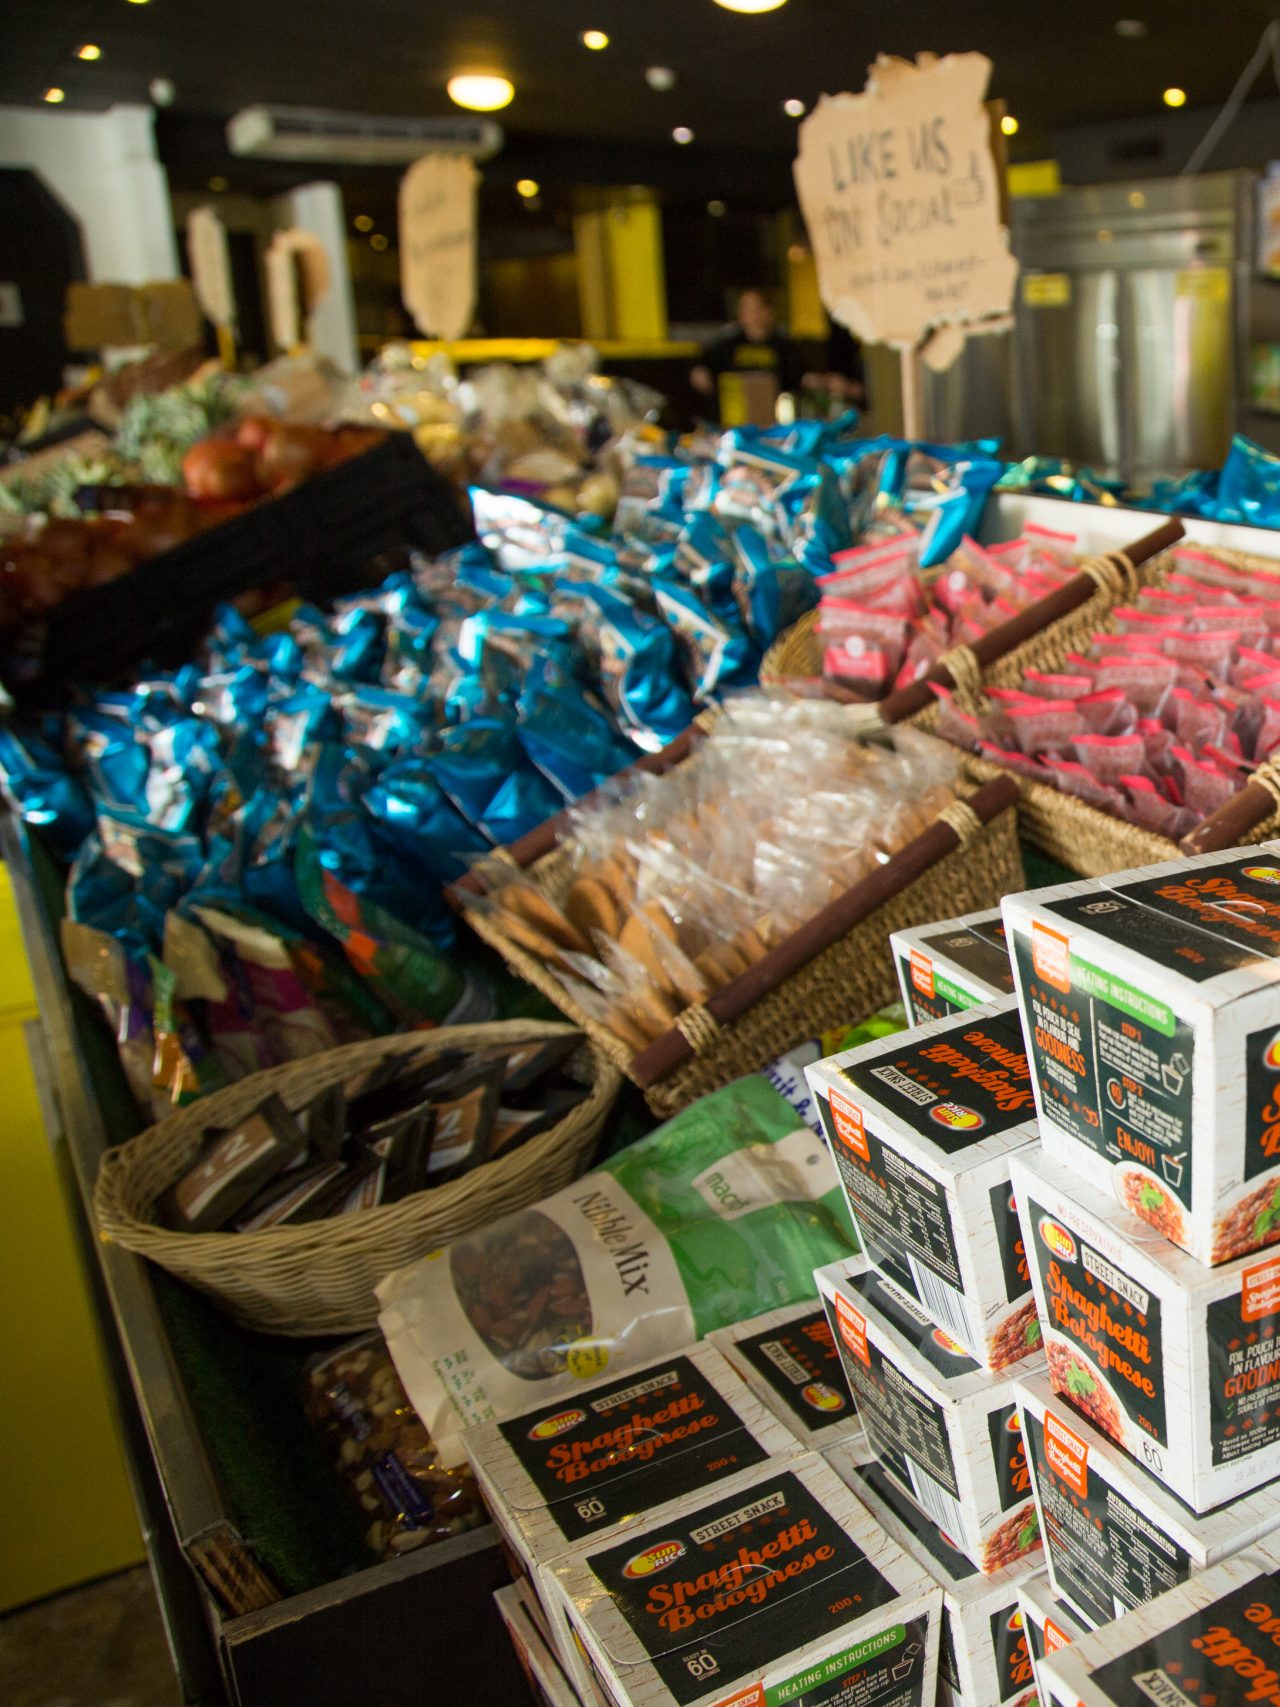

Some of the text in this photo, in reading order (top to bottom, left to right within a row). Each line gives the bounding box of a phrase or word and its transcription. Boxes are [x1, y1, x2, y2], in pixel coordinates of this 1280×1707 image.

[827, 115, 949, 192] LIKE US
[1110, 981, 1168, 1025] INSTRUCTIONS
[1035, 1025, 1086, 1077] GOODNESS
[876, 1066, 933, 1104] STREET SNACK
[912, 1044, 1035, 1110] Spaghetti
[1116, 1127, 1156, 1168] ENJOY!
[572, 1191, 649, 1297] Nibble Mix
[1052, 1227, 1072, 1249] Sun
[1057, 1204, 1123, 1263] NO PRESERVATIVES
[1084, 1250, 1145, 1307] STREET SNACK
[1046, 1261, 1153, 1364] Spaghetti
[1050, 1294, 1156, 1399] Bolognese
[1229, 1353, 1245, 1366] FOIL
[1247, 1339, 1273, 1358] POUCH
[596, 1375, 675, 1410] STREET SNACK
[1233, 1364, 1243, 1376] IN
[546, 1392, 705, 1470] Spaghetti
[707, 1459, 728, 1472] 200
[1141, 1440, 1162, 1473] 60
[578, 1501, 605, 1519] 60
[696, 1496, 783, 1542] STREET SNACK
[1107, 1490, 1137, 1520] NUTRITION
[1136, 1512, 1177, 1560] INFORMATION
[645, 1519, 818, 1614] Spaghetti
[648, 1545, 677, 1564] Sun
[658, 1544, 836, 1633] Bolognese
[828, 1599, 852, 1614] 200
[687, 1654, 718, 1676] 60
[778, 1630, 897, 1699] HEATING INSTRUCTIONS
[842, 1674, 862, 1687] STEP
